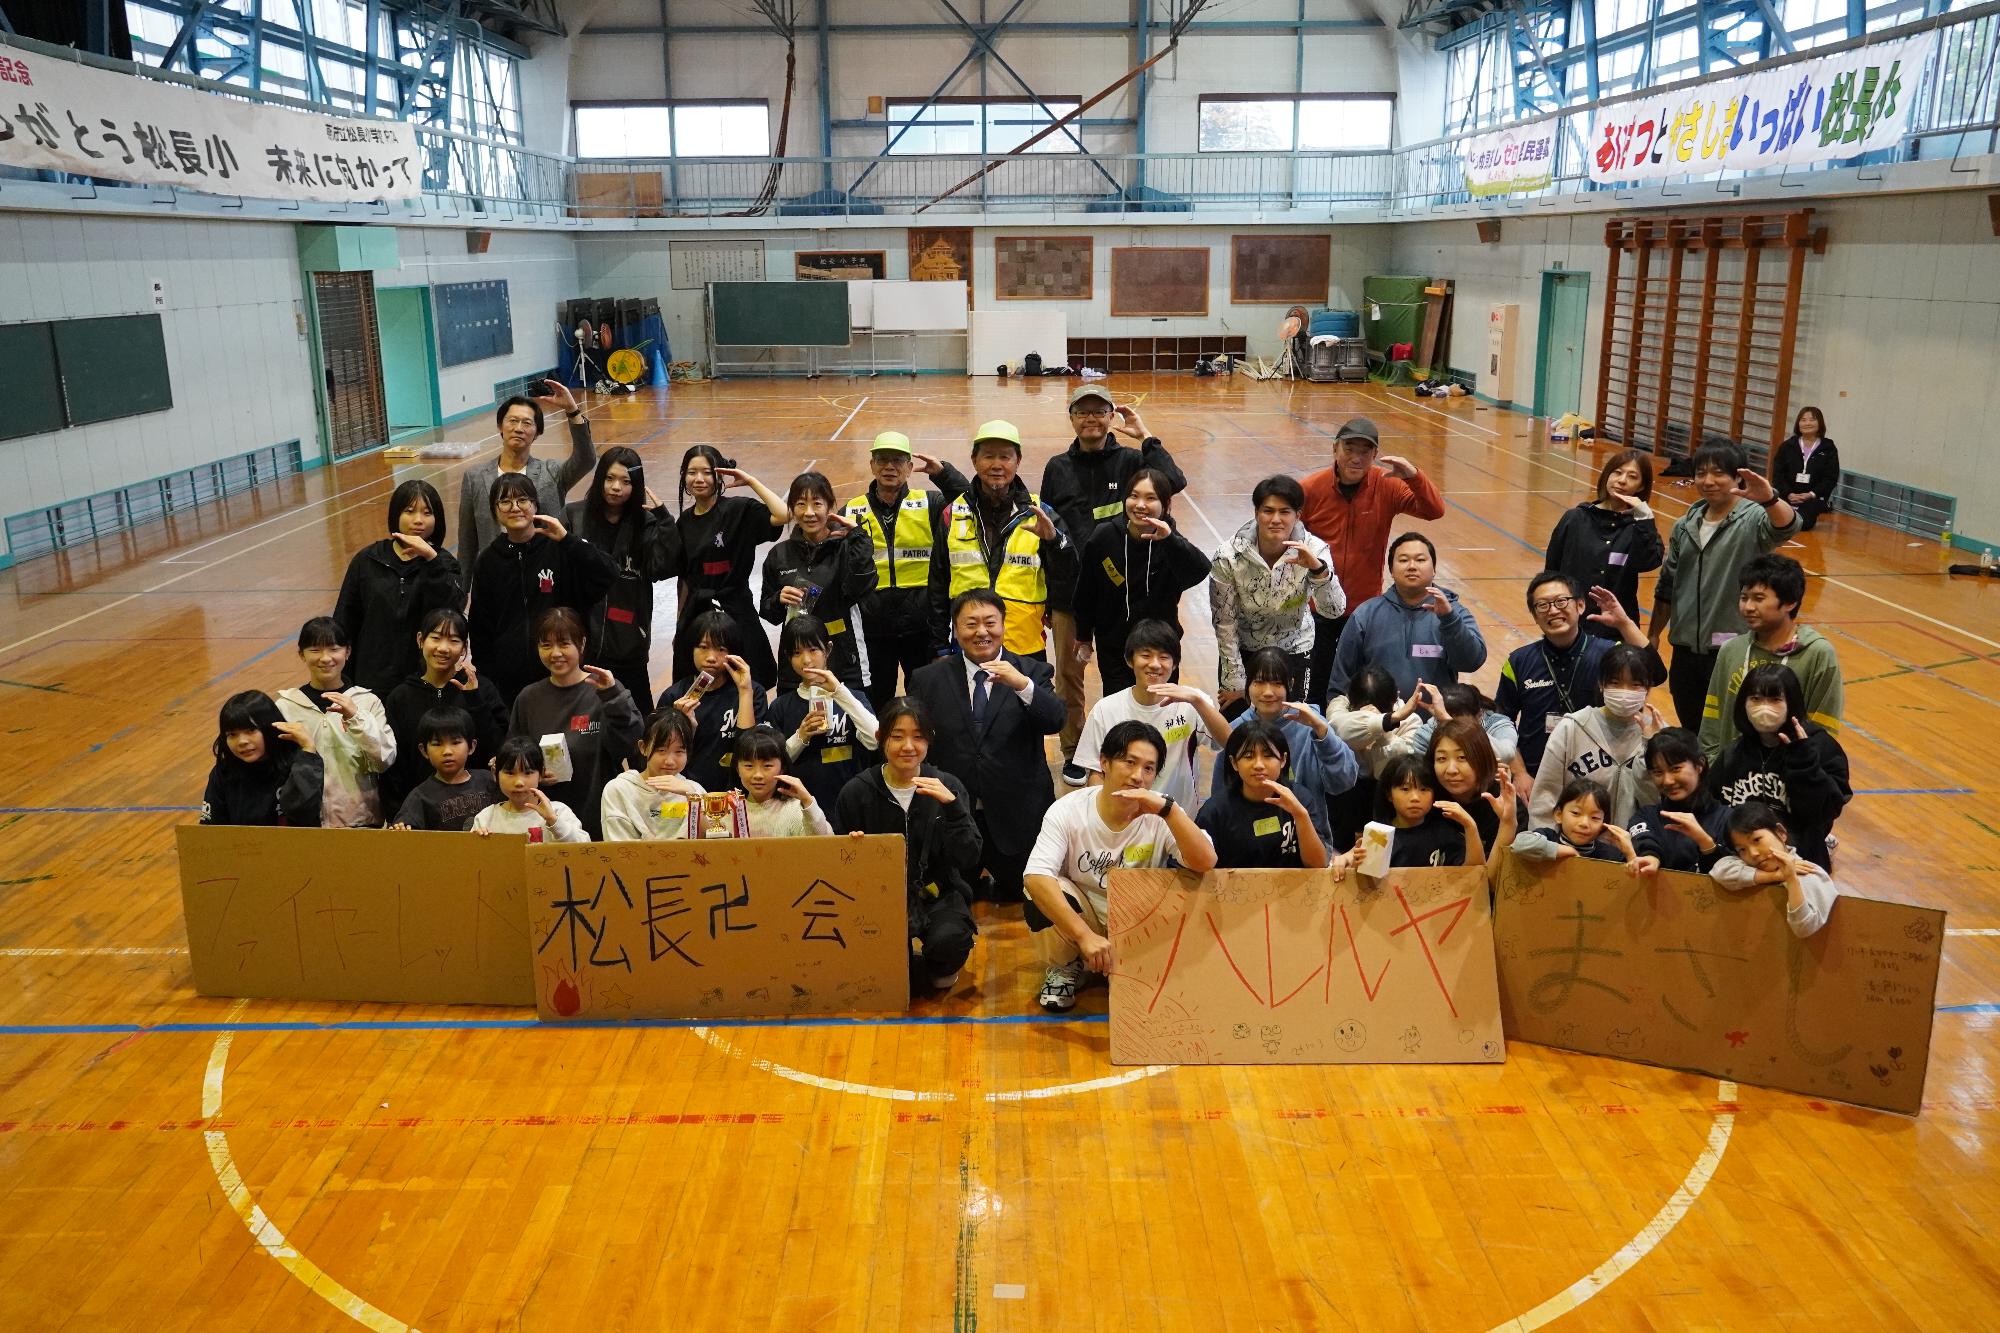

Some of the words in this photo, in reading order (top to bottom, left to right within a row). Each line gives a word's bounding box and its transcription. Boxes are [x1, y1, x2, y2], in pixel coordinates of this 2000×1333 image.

[902, 549, 930, 559] PATROL
[1147, 884, 1473, 1019] ハレルヤ
